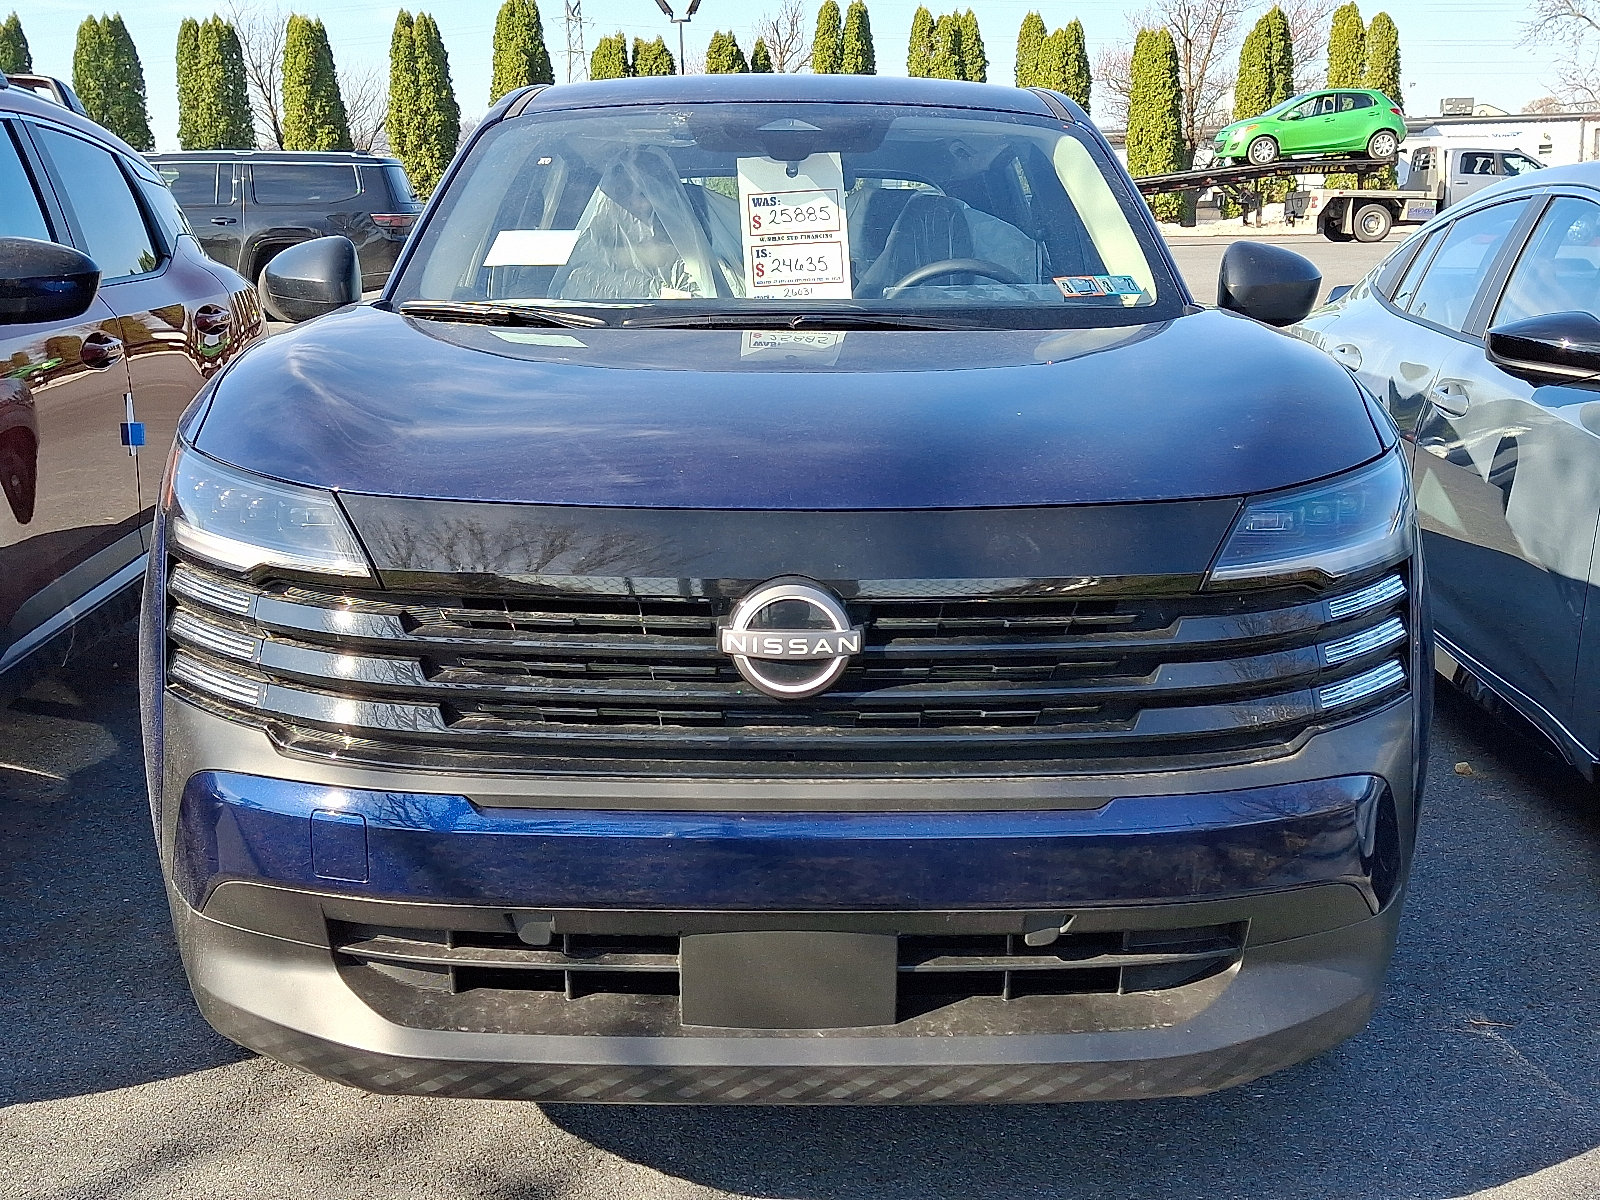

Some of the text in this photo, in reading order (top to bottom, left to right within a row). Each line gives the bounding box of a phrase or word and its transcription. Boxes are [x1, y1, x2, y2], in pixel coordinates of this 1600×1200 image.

[752, 196, 781, 207] WAS:
[769, 206, 831, 225] 25885
[755, 248, 772, 258] IS:
[771, 256, 828, 273] 24635
[726, 634, 858, 655] NISSAN
